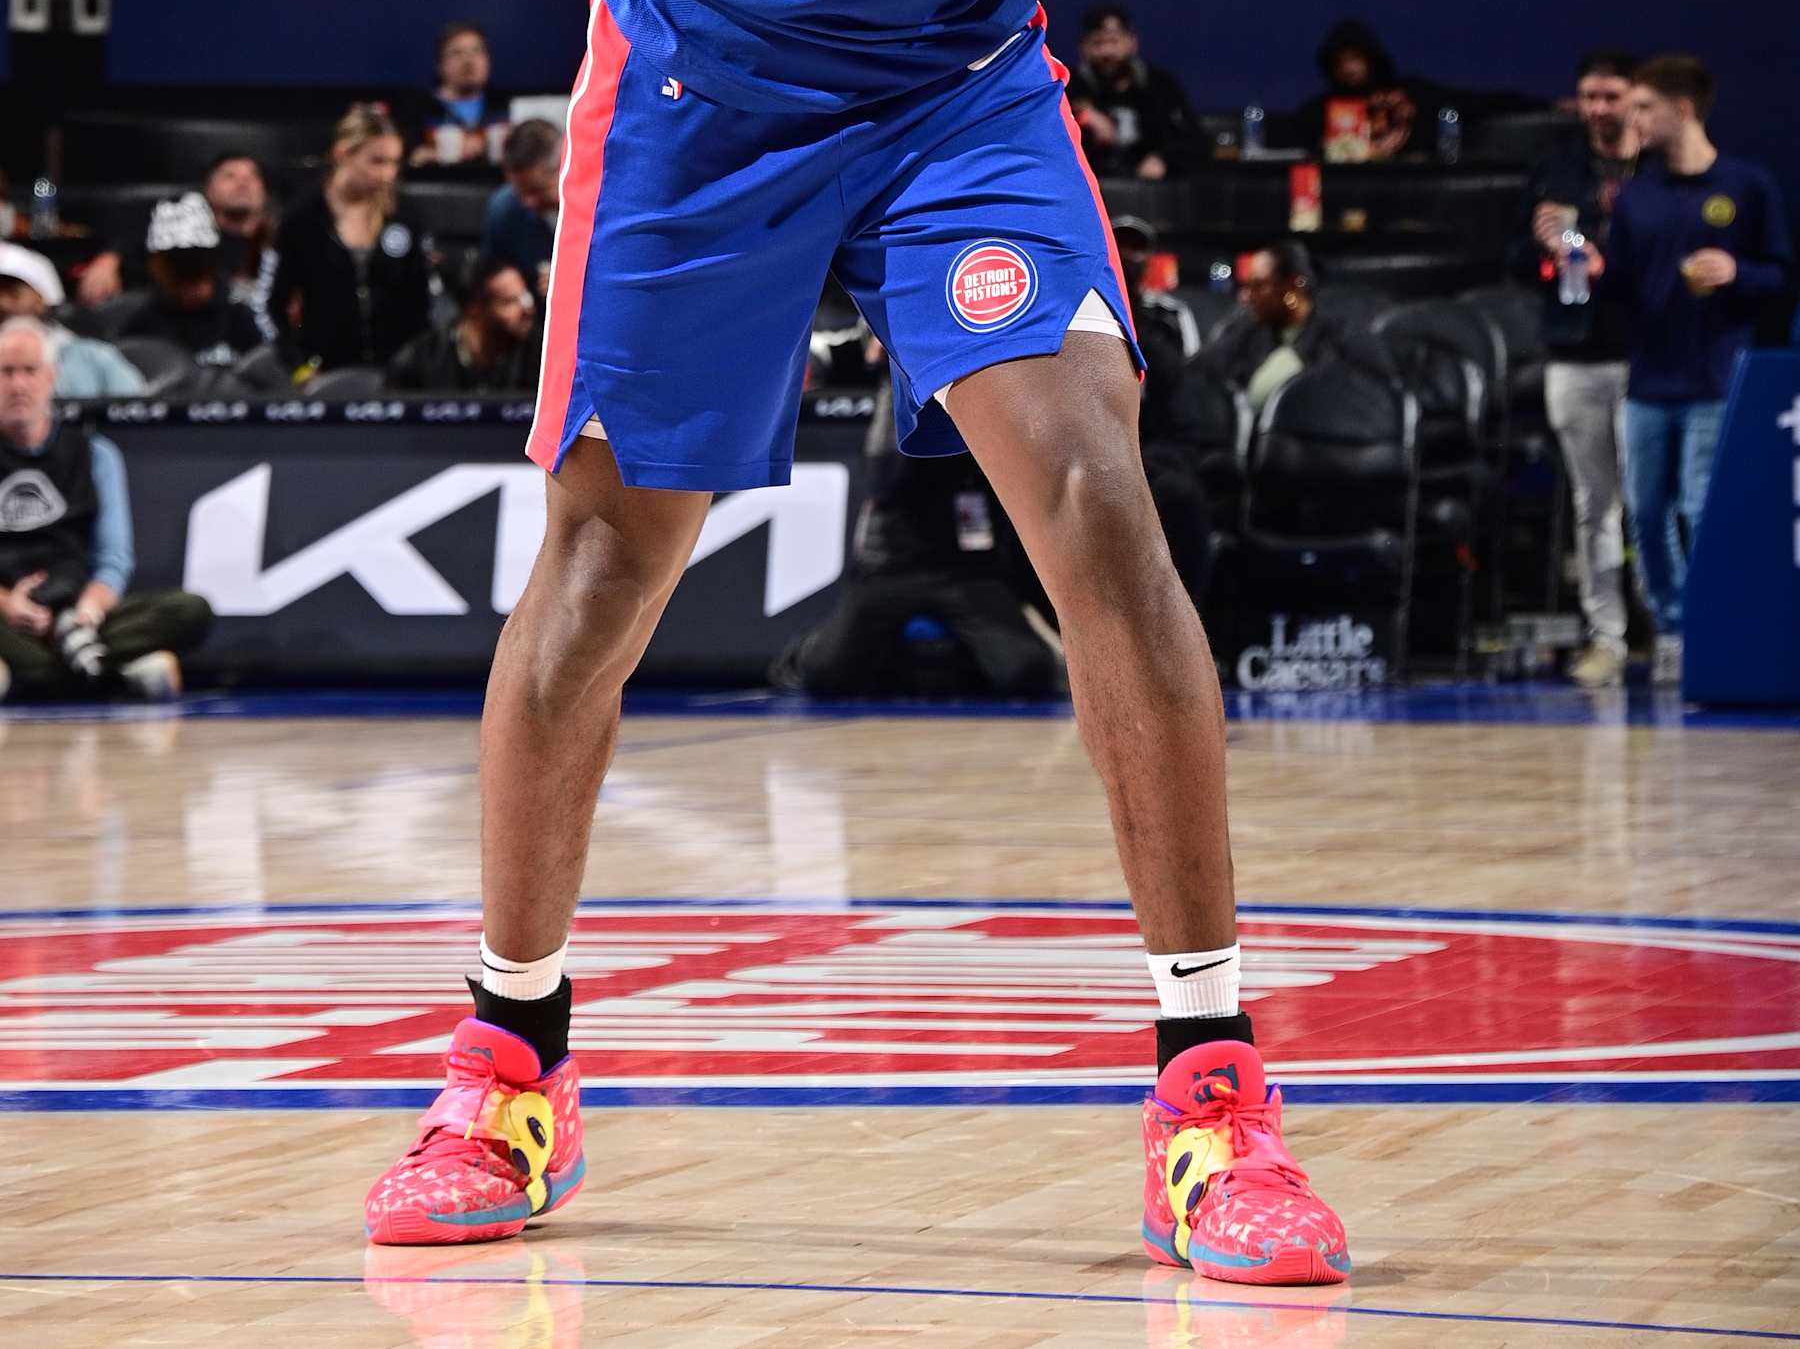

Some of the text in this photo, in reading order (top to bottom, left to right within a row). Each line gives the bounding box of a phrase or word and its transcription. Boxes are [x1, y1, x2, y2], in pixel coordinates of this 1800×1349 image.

[963, 267, 1016, 289] DETROIT
[963, 282, 1018, 304] PISTONS
[1269, 614, 1374, 658] Little
